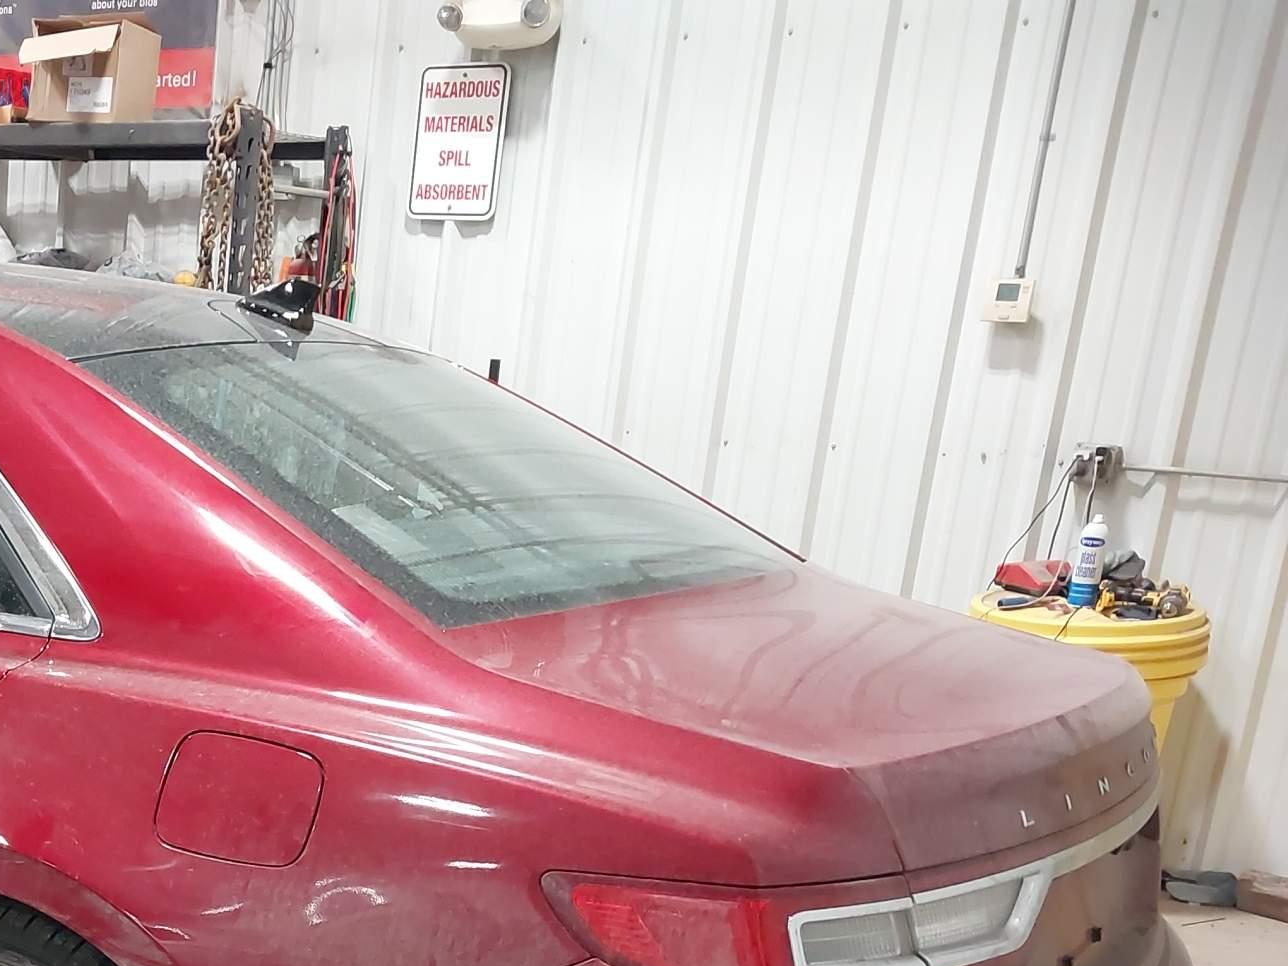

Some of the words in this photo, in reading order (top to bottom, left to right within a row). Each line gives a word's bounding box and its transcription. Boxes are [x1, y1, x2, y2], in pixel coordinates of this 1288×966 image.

[91, 0, 115, 10] about
[117, 0, 138, 10] your
[425, 79, 501, 99] HAZARDOUS
[423, 115, 494, 133] MATERIALS
[438, 150, 471, 167] SPILL
[415, 183, 489, 201] ABSORBENT
